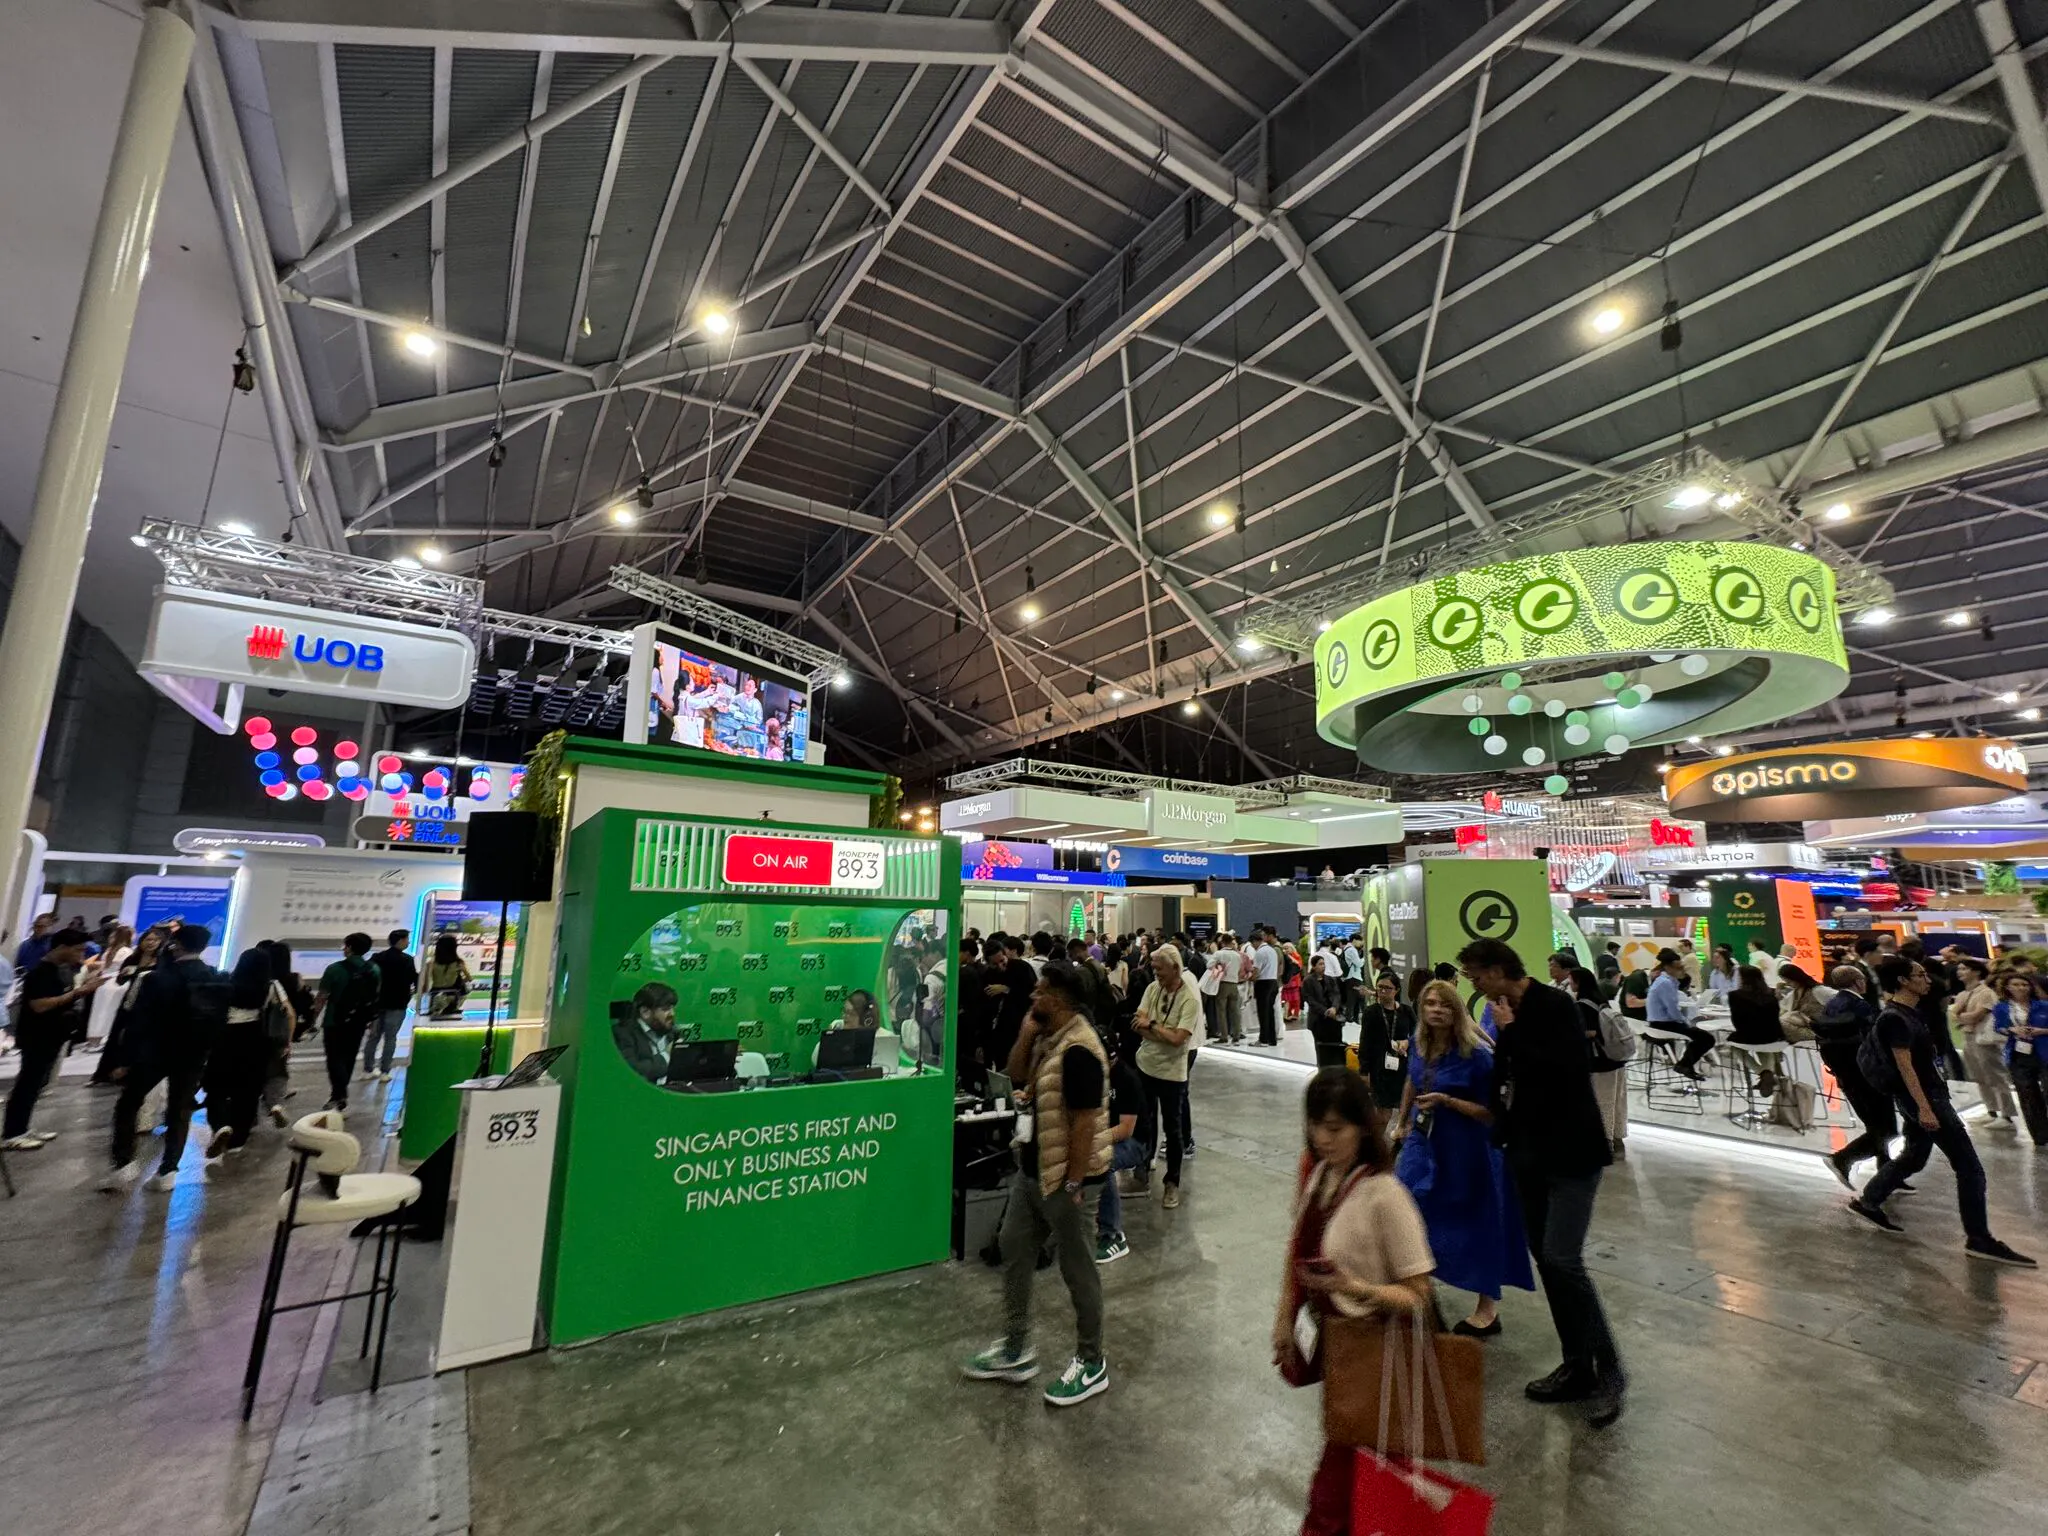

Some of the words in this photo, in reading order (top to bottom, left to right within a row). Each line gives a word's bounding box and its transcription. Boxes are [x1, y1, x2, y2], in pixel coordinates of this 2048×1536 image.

[294, 634, 384, 672] UOB
[1162, 803, 1226, 828] J.P.Morgan
[1503, 800, 1541, 818] HUAWEI
[414, 821, 444, 833] UOB
[753, 853, 779, 868] ON
[783, 855, 808, 869] AIR
[837, 858, 878, 879] 89.3
[1162, 853, 1208, 866] coinbase
[617, 958, 641, 972] 9.3
[488, 1117, 537, 1143] 89.3
[654, 1122, 799, 1160] SINGAPORE'S
[804, 1117, 852, 1141] FIRST
[854, 1112, 897, 1134] AND
[673, 1157, 737, 1185] ONLY
[741, 1145, 832, 1176] BUSINESS
[836, 1140, 880, 1162] AND
[685, 1178, 784, 1213] FINANCE
[787, 1167, 868, 1196] STATION
